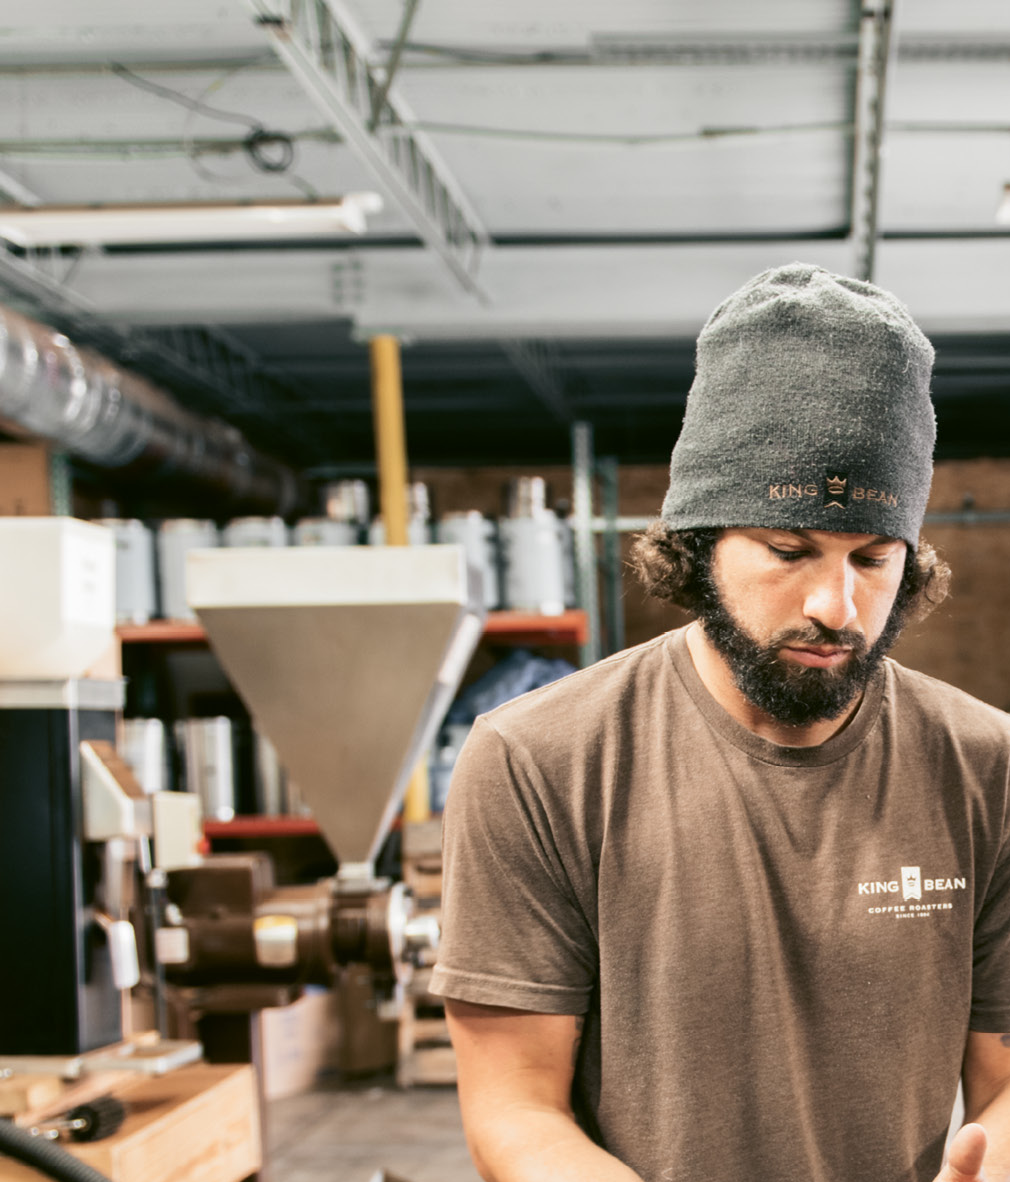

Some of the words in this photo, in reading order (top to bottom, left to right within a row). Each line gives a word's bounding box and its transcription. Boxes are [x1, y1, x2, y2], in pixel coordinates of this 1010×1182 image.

[769, 484, 818, 499] KING
[852, 487, 898, 507] BEAN
[858, 881, 899, 895] KING
[924, 878, 966, 891] BEAN
[868, 905, 906, 914] COFFEE
[909, 903, 953, 911] ROASTERS
